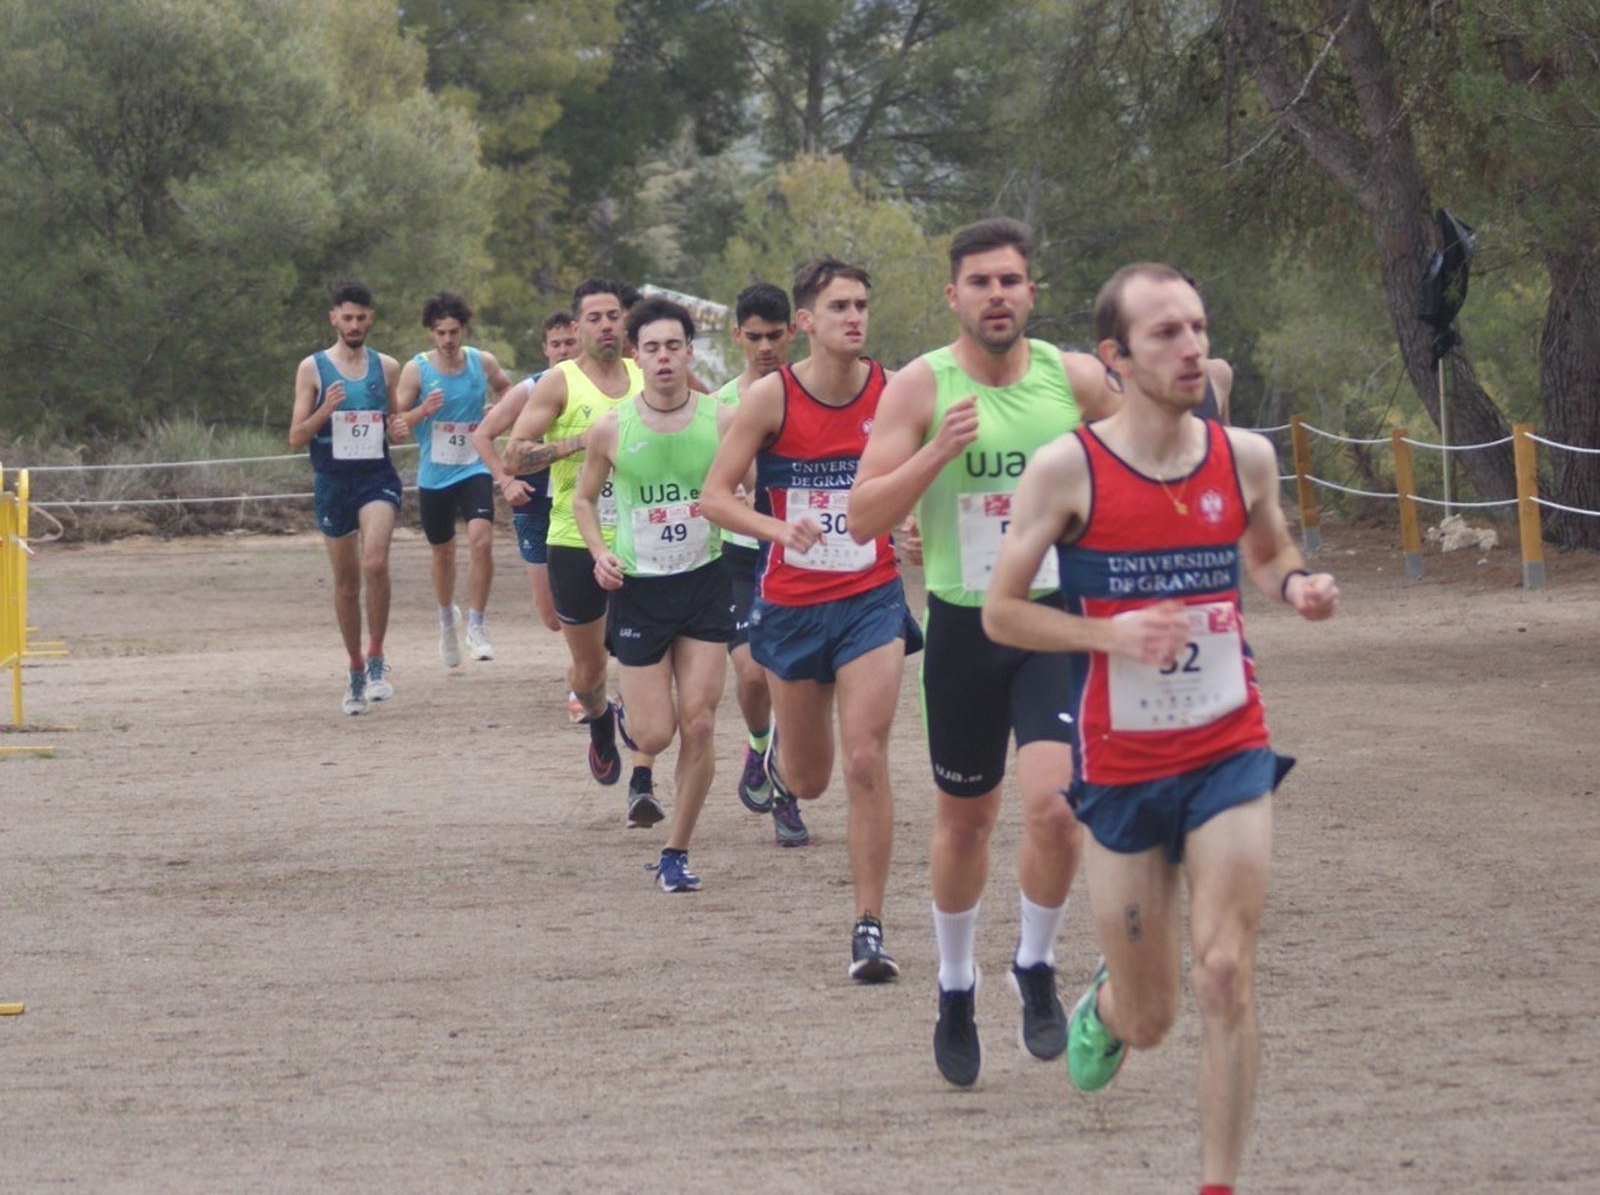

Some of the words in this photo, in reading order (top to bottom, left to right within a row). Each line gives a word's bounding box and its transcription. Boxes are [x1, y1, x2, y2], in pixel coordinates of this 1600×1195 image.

[351, 424, 370, 438] 67
[448, 434, 466, 446] 43
[791, 475, 811, 487] DE
[820, 512, 848, 535] 30
[661, 523, 688, 543] 49
